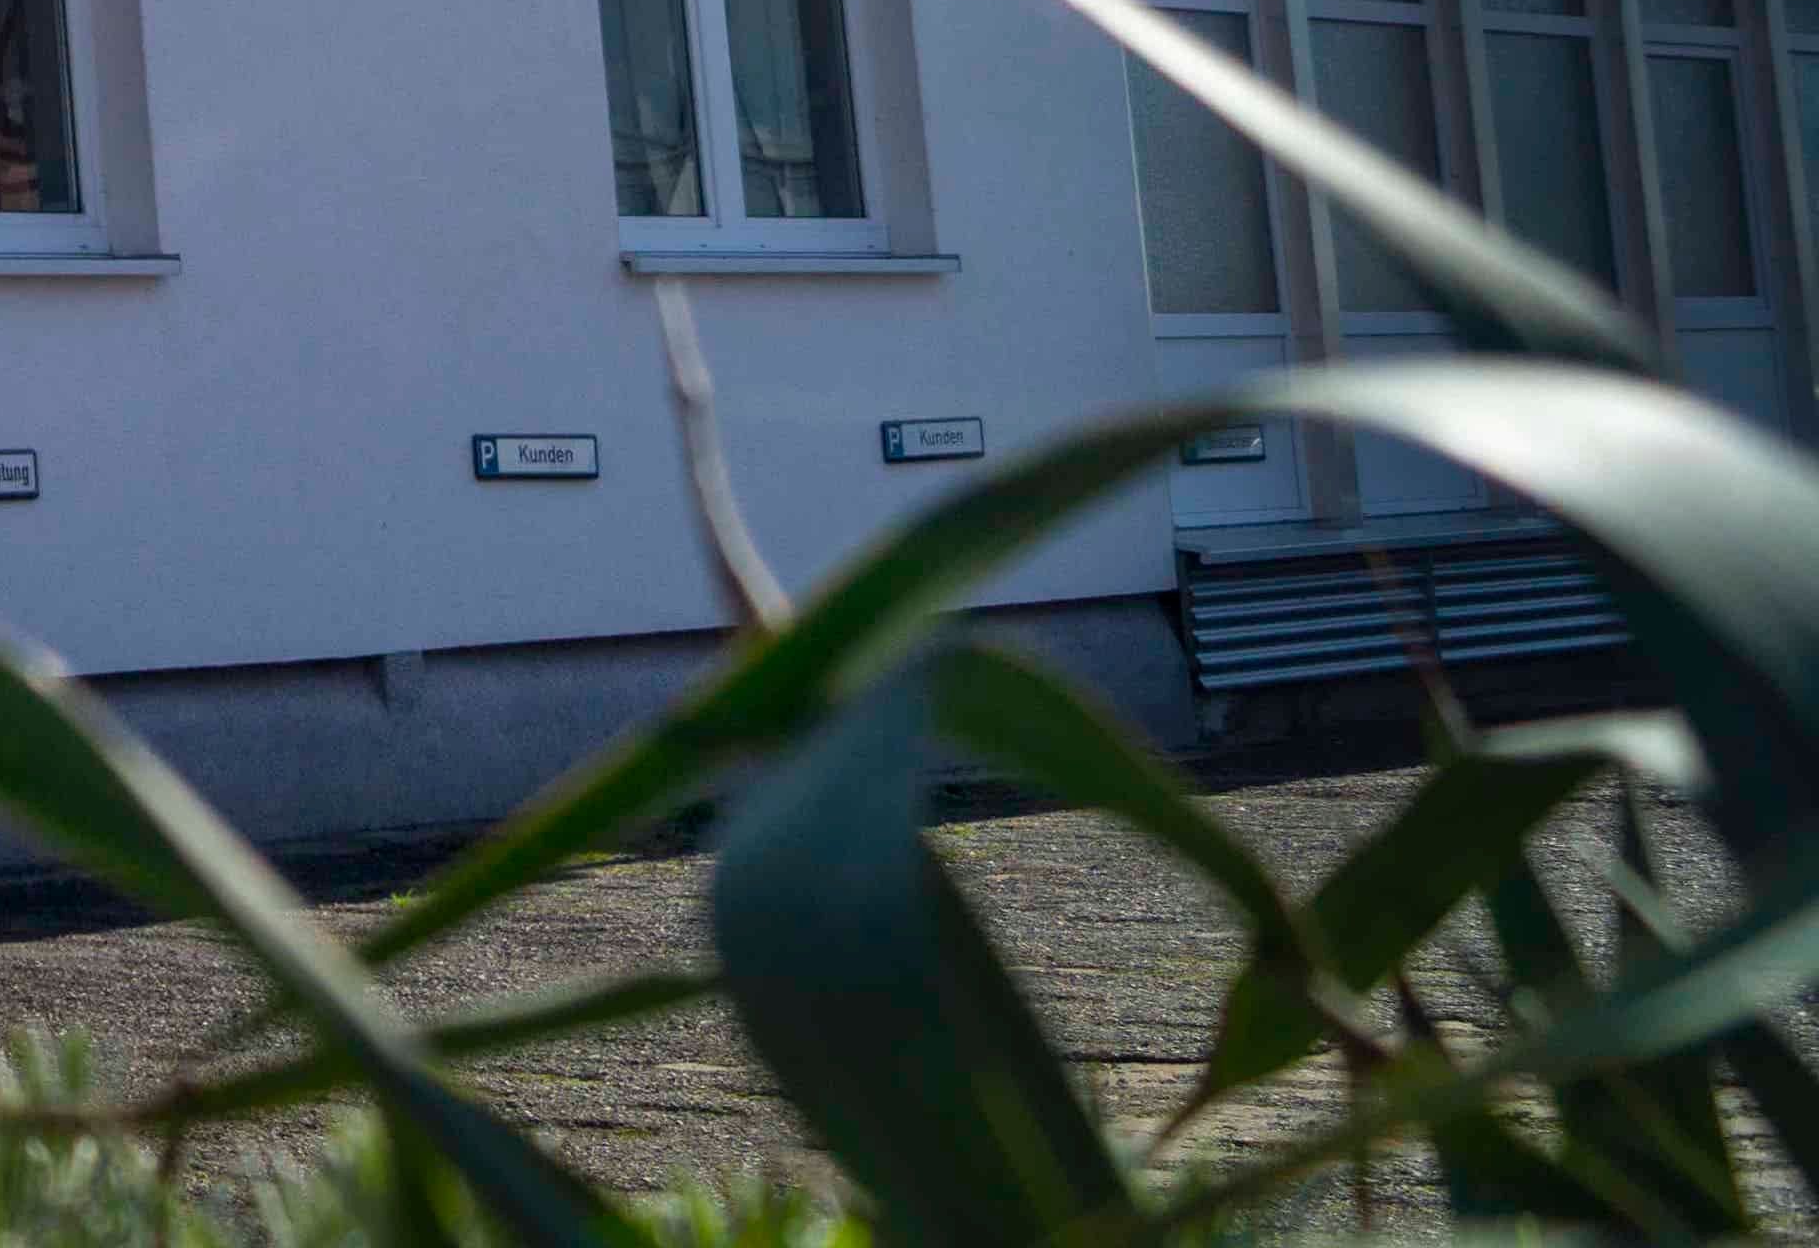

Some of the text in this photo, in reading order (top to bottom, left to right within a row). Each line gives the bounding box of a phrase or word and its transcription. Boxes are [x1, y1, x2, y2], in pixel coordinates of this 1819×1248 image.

[919, 429, 964, 447] Kunden
[480, 441, 575, 469] P Kunden
